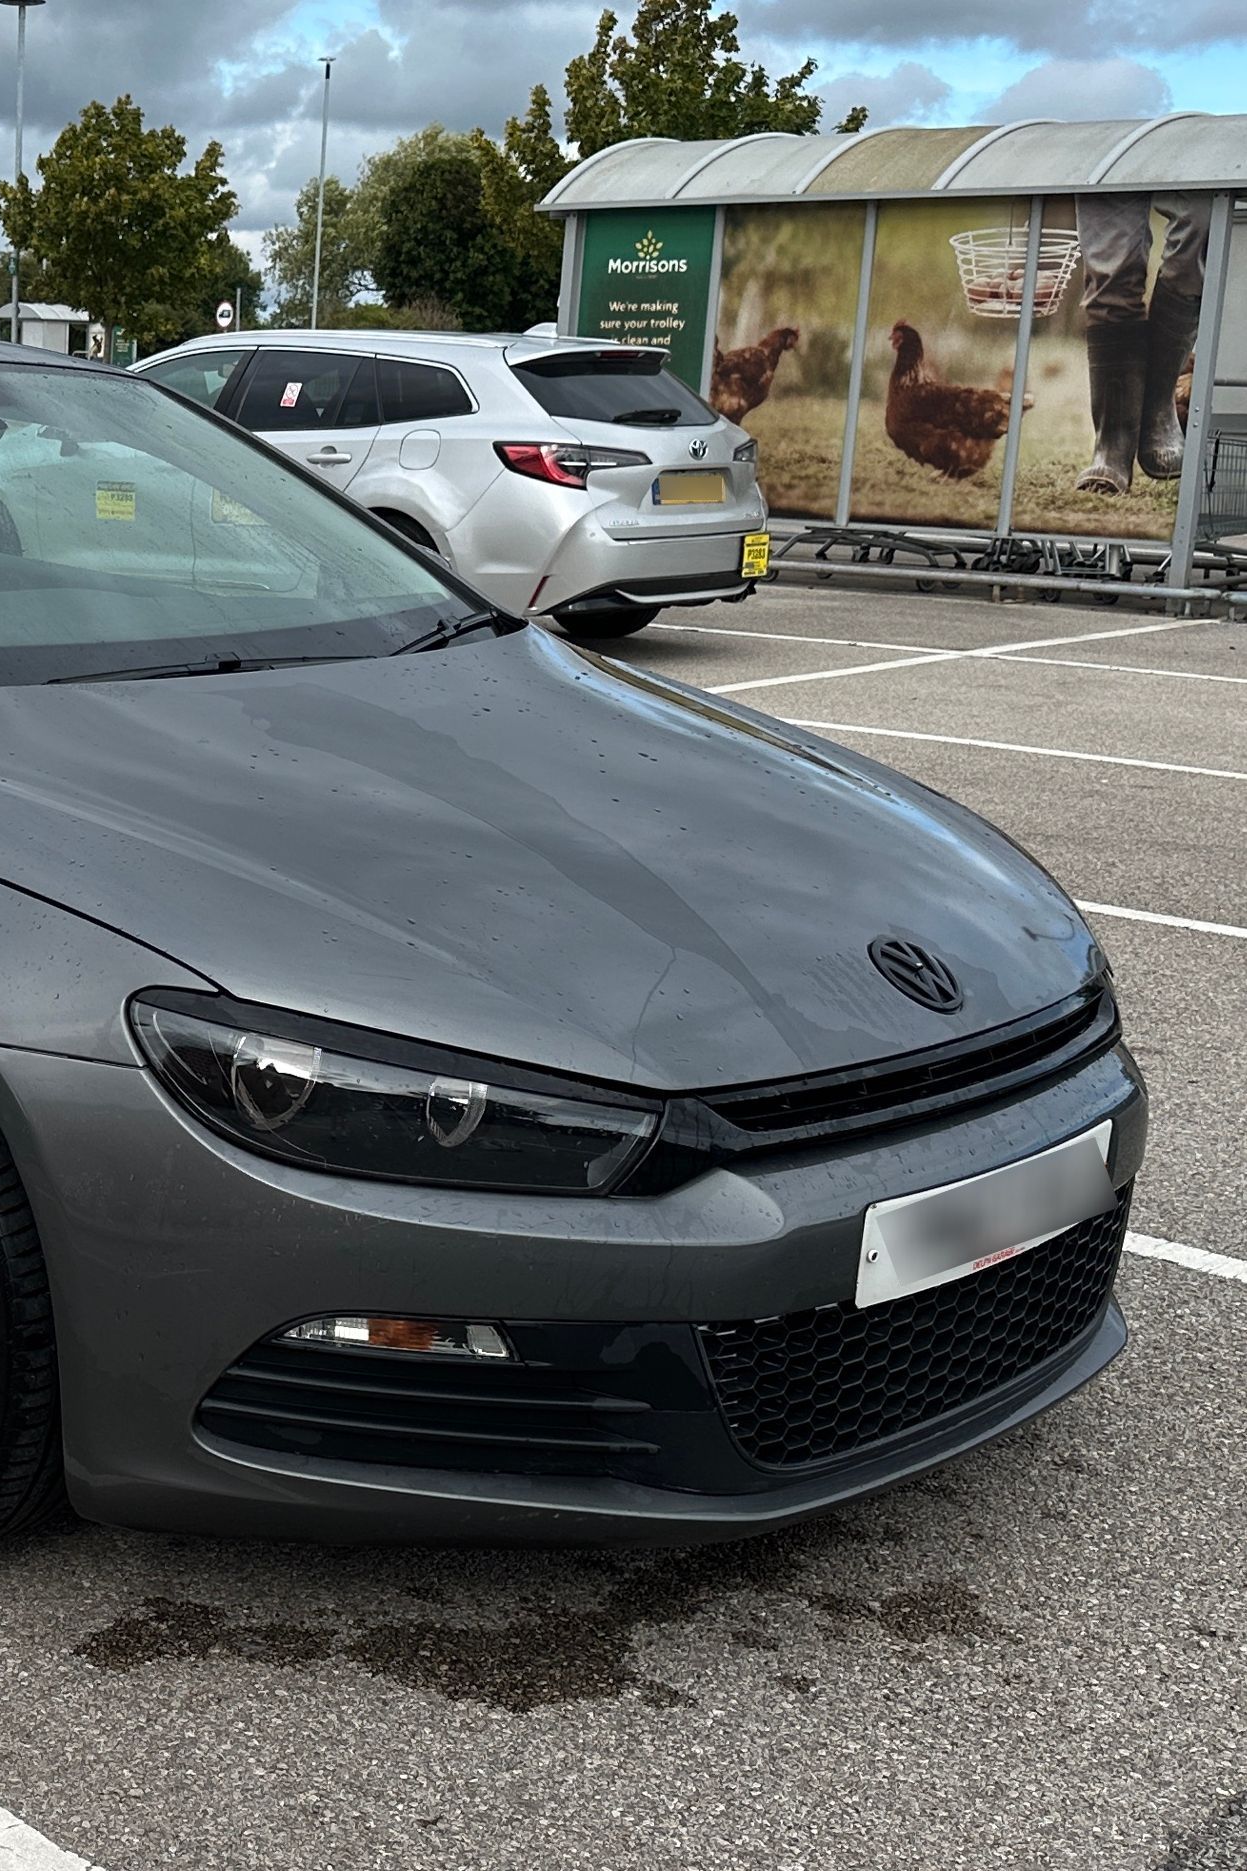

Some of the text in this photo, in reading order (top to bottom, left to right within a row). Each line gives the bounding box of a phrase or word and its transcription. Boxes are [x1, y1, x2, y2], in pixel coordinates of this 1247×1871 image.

[607, 258, 688, 274] Morrisons
[609, 300, 678, 314] We're making
[599, 317, 686, 331] sure your trolley
[621, 334, 649, 345] clean
[650, 334, 672, 345] and
